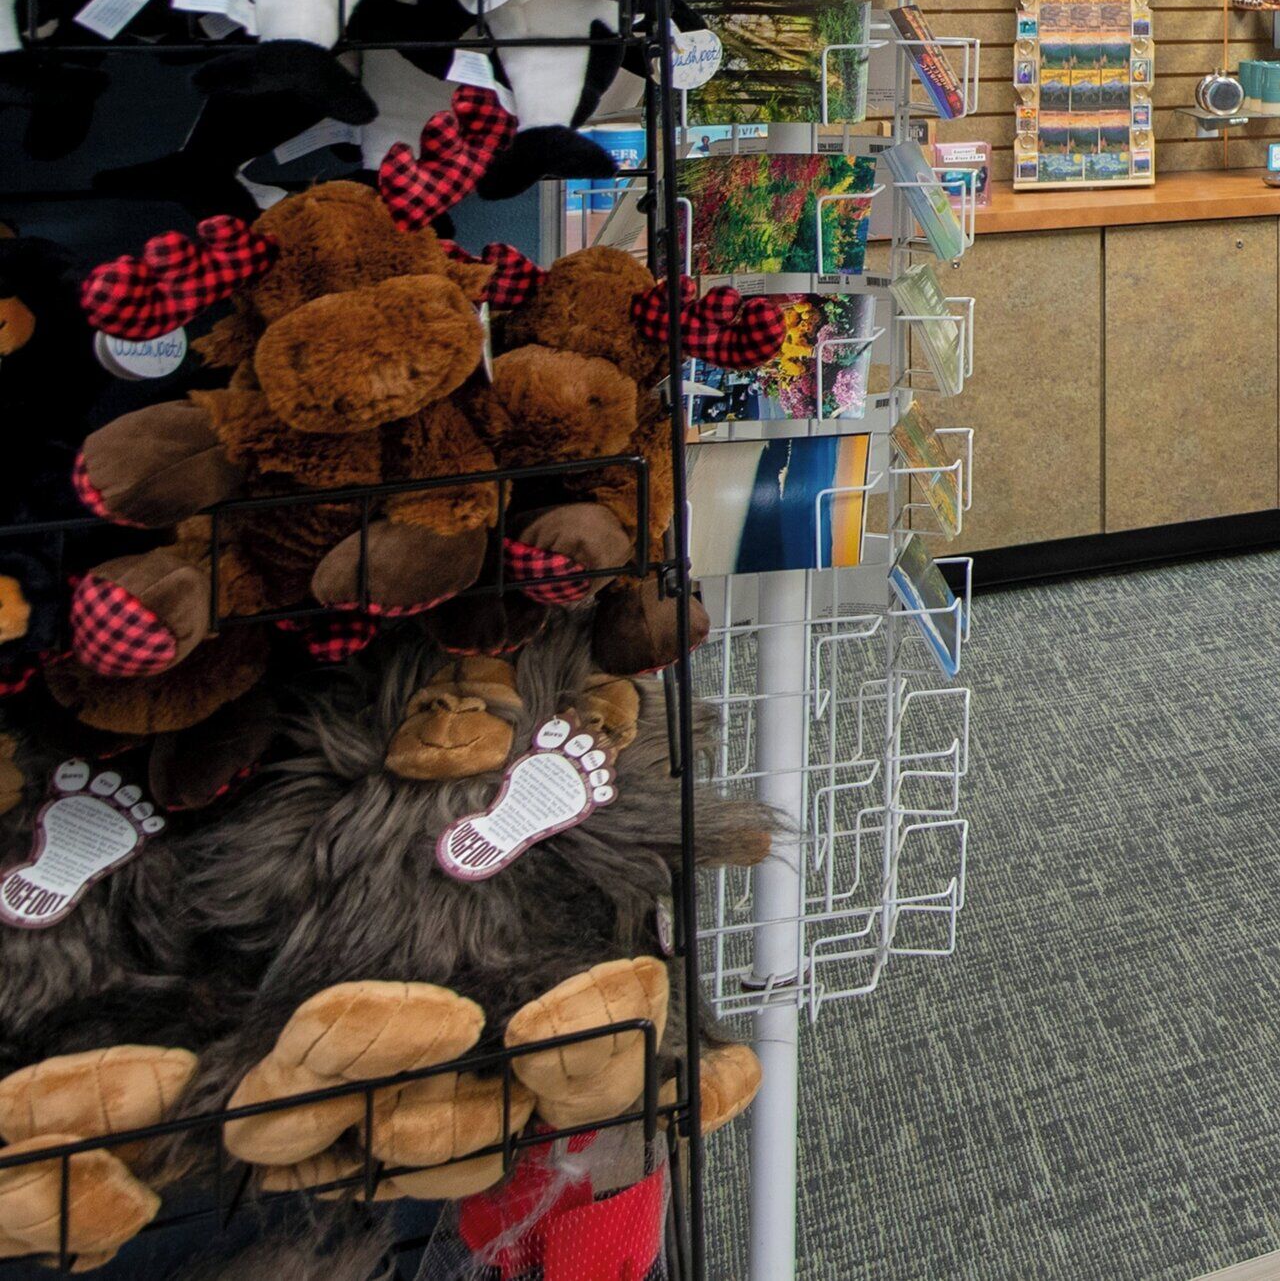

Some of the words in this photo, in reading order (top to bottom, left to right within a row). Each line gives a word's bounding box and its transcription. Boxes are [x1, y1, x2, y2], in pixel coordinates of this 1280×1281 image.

[611, 148, 639, 160] EER
[450, 821, 505, 868] BIGFOOT
[4, 874, 68, 916] BIGFOOT
